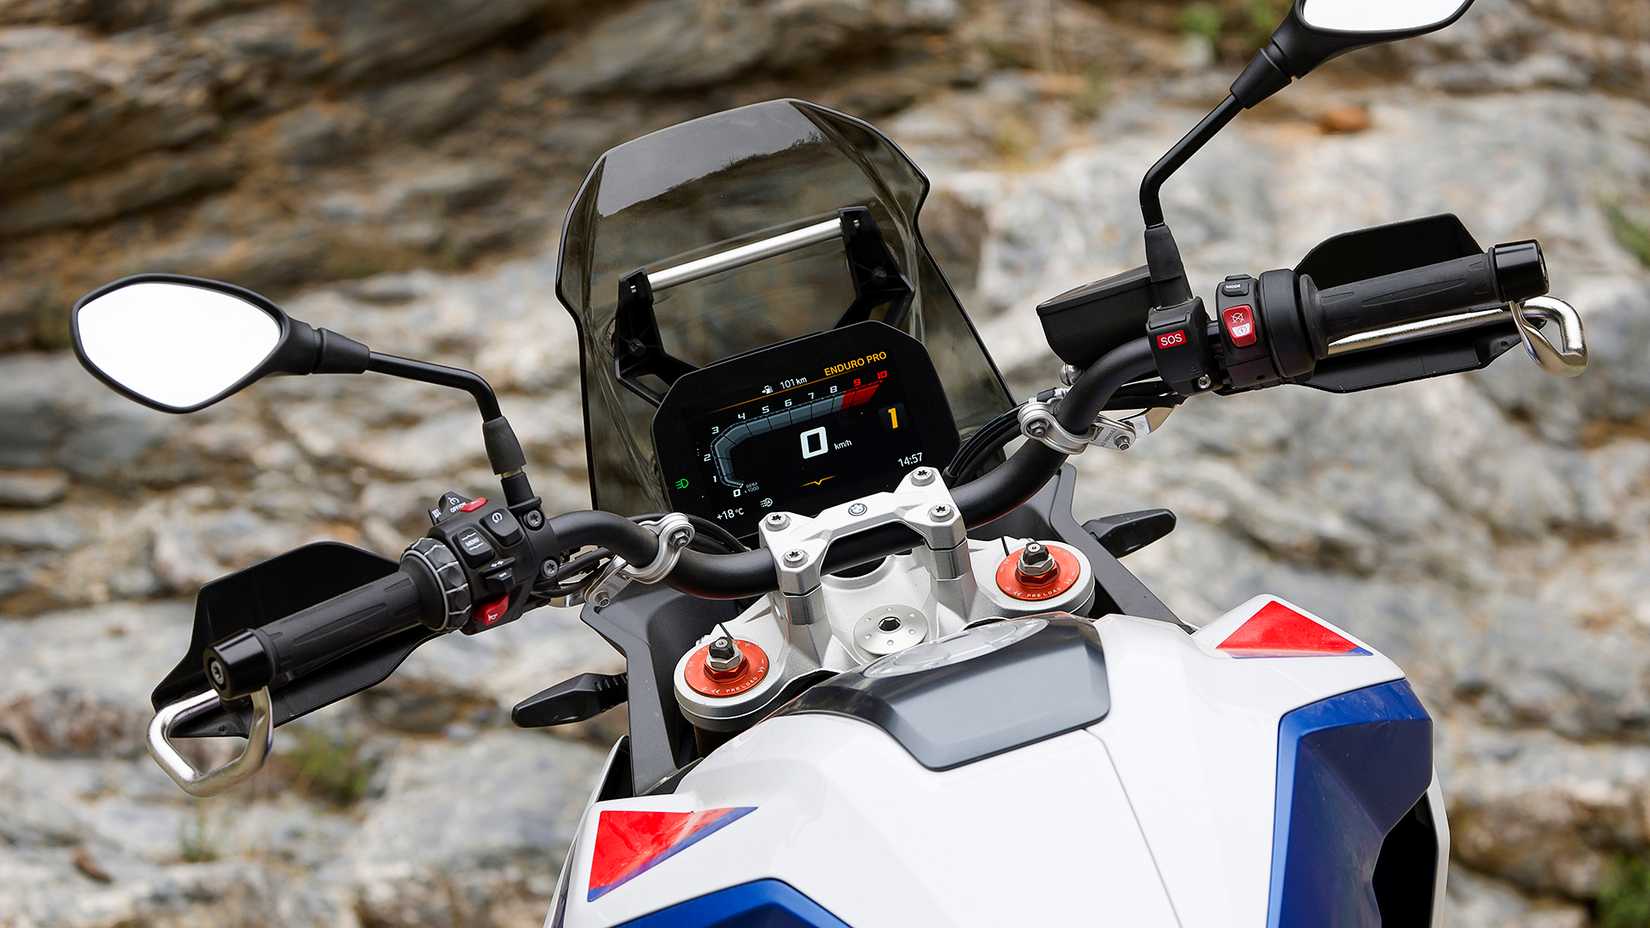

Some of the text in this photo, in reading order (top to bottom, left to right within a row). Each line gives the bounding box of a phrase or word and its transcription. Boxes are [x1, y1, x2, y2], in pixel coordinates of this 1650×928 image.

[1160, 333, 1183, 346] SOS
[824, 351, 887, 376] ENDURO PRO
[876, 370, 888, 379] 10
[780, 376, 808, 390] 101 km
[853, 378, 861, 387] 9
[829, 385, 838, 394] 8
[808, 392, 815, 400] 7
[784, 399, 792, 408] 6
[761, 405, 770, 414] 5
[737, 412, 746, 420] 4
[887, 407, 899, 430] 1
[711, 426, 720, 435] 3
[800, 426, 829, 460] 0
[833, 439, 853, 451] km/h
[703, 453, 711, 462] 2
[897, 452, 923, 468] 14:57
[712, 475, 718, 483] 1
[733, 488, 741, 497] 0
[717, 508, 735, 520] +18
